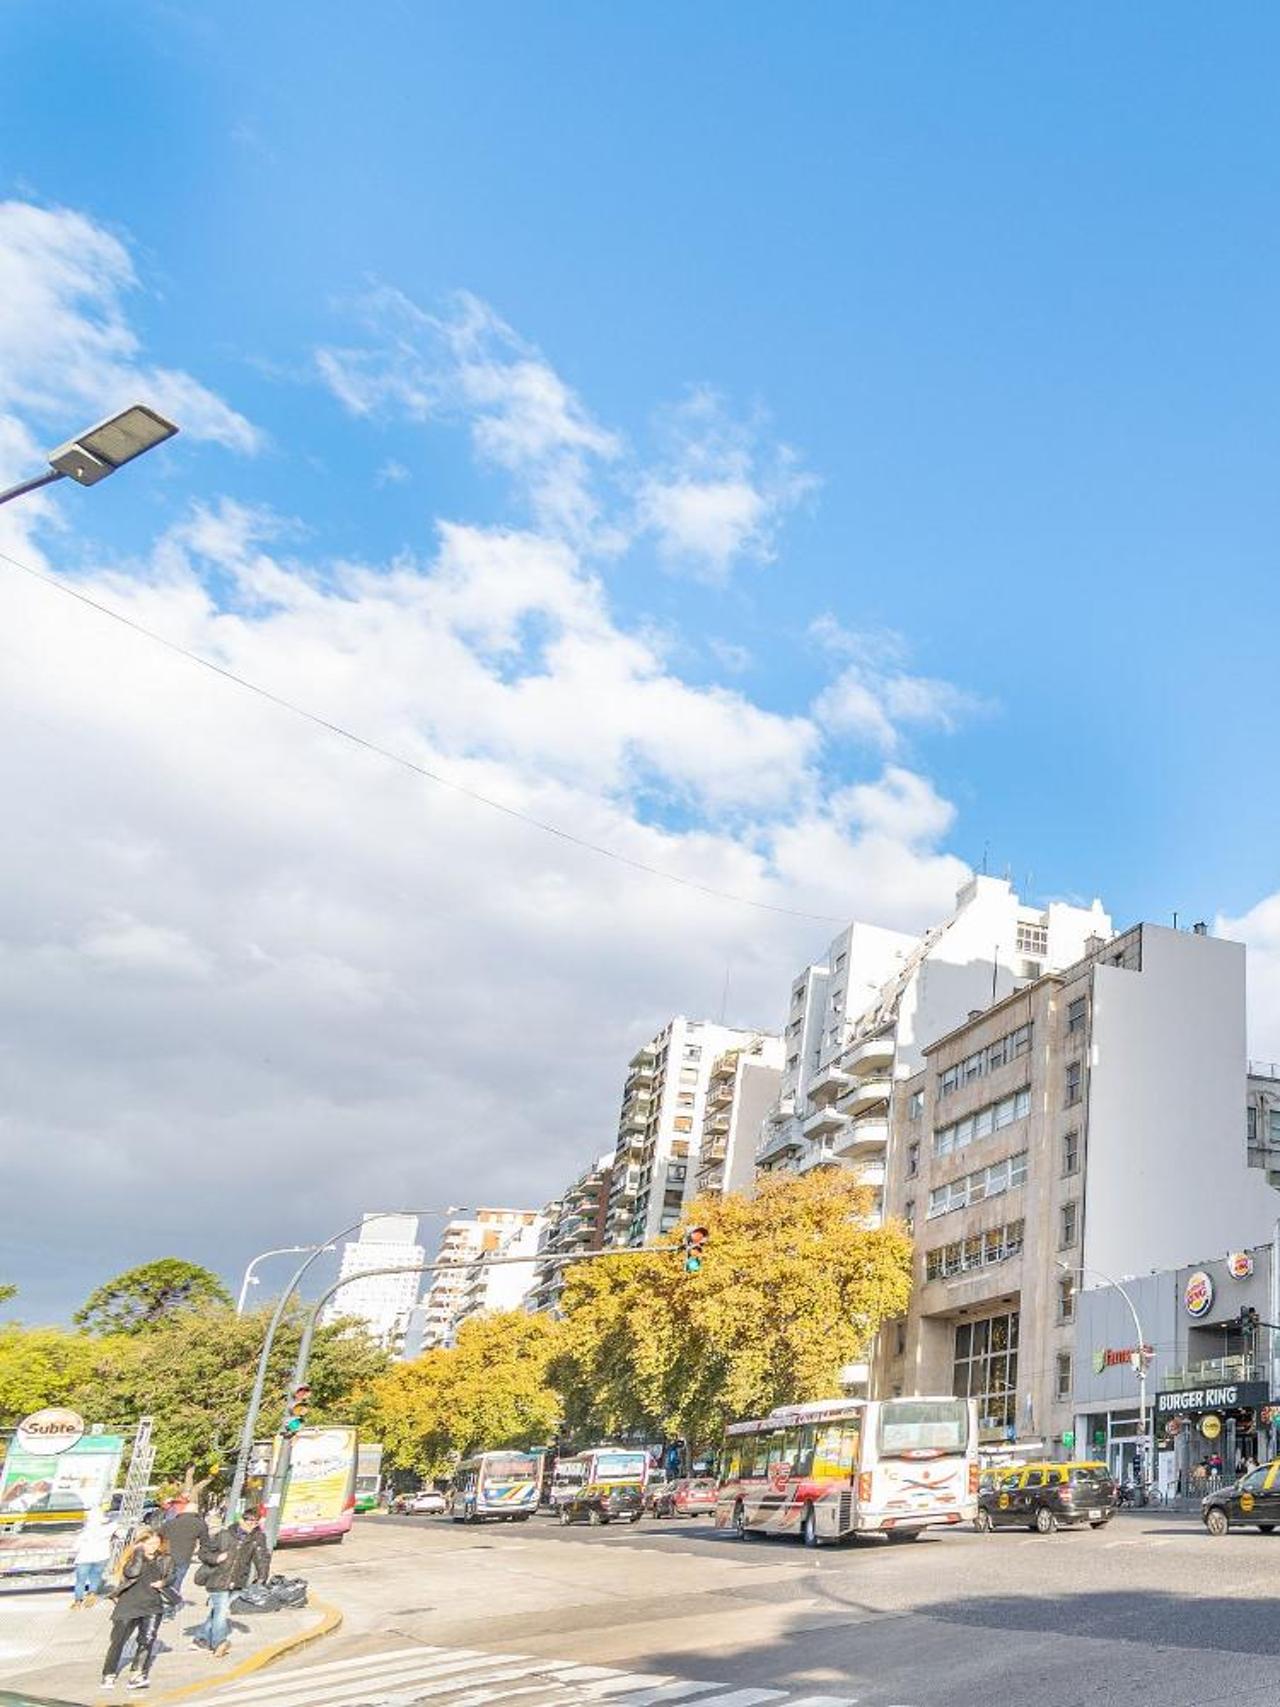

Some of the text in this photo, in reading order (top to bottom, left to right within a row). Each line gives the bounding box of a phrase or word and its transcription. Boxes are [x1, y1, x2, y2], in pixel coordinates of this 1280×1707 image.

[1158, 1385, 1239, 1411] BURGER KING
[28, 1422, 76, 1435] Subte
